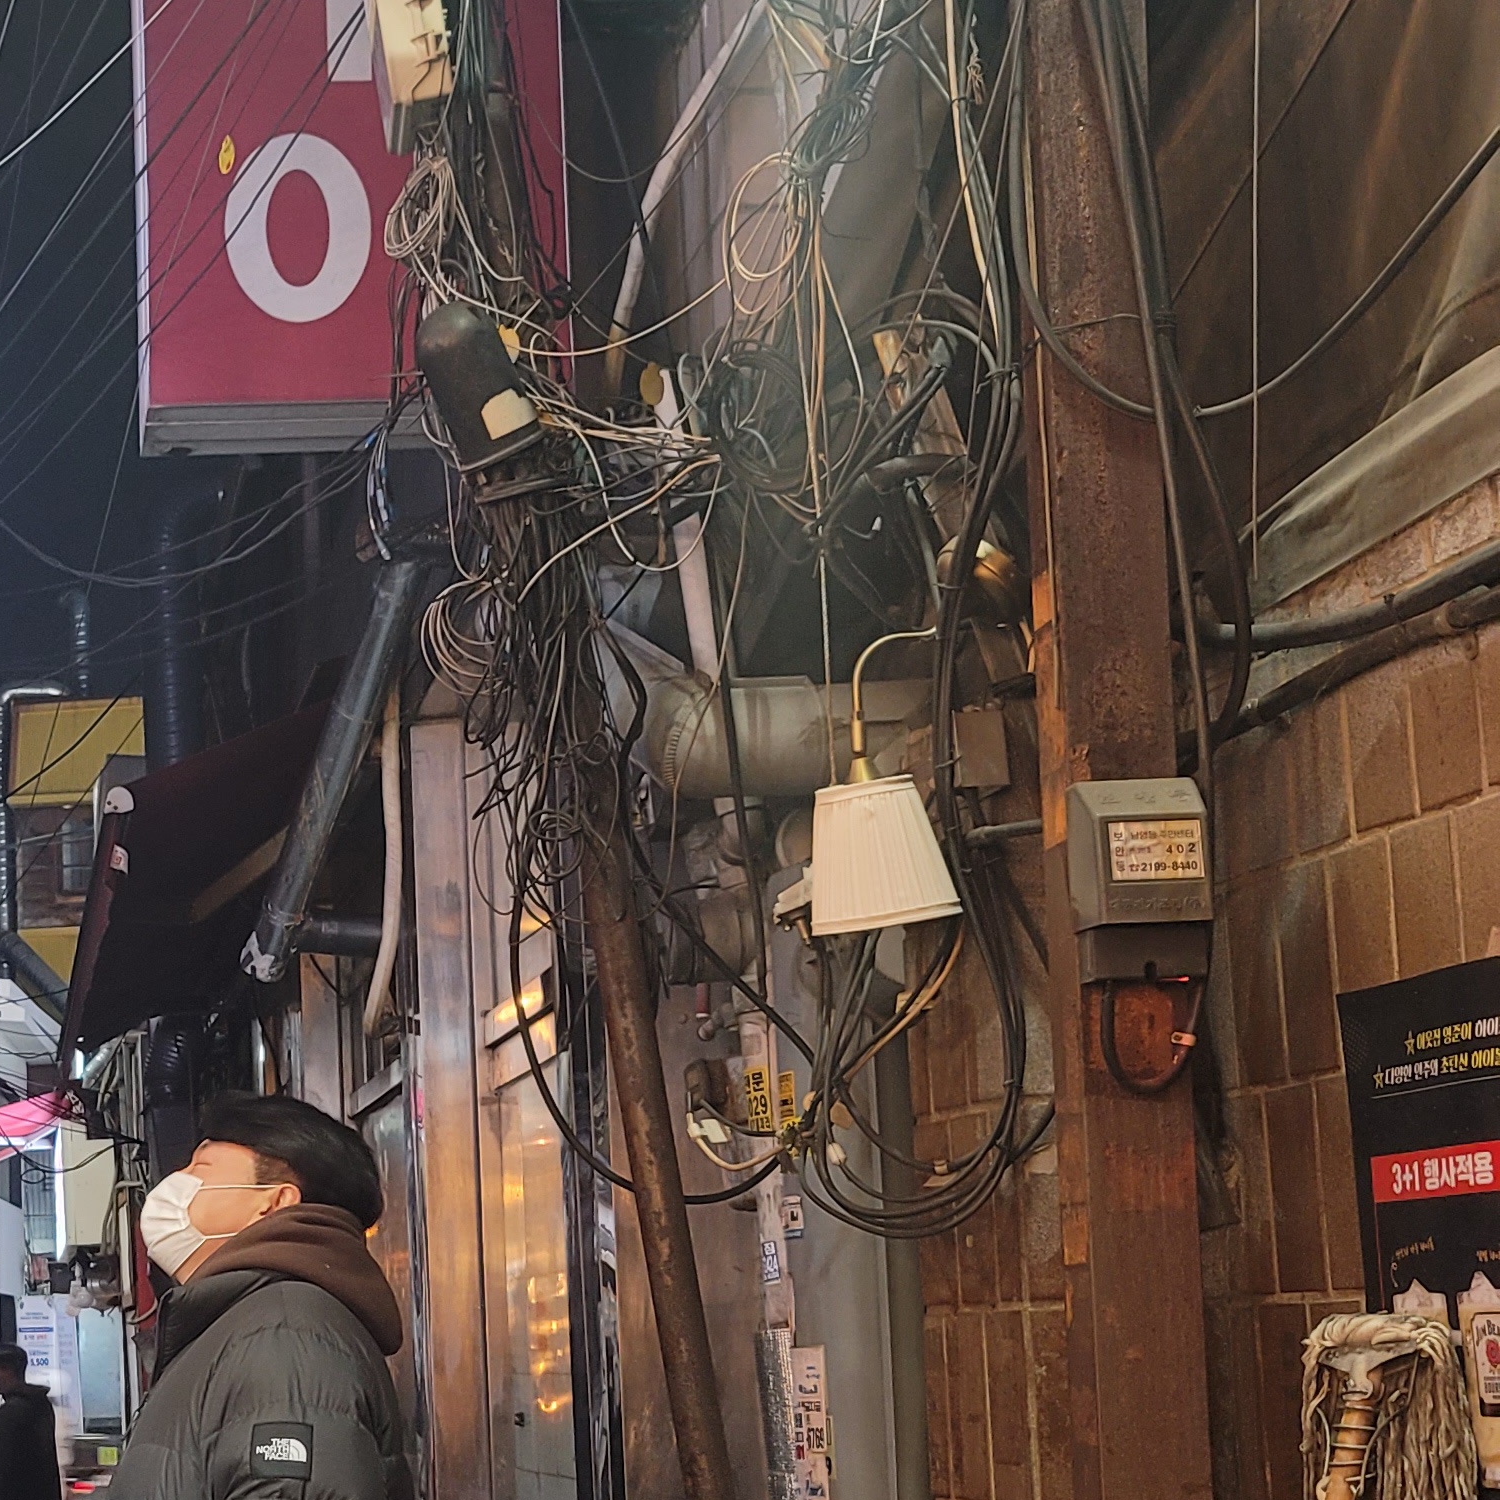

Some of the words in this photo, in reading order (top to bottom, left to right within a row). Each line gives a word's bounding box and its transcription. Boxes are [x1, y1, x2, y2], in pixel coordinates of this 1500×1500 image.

[1141, 860, 1198, 872] 2199-8440
[1416, 1031, 1441, 1051] 이웃집
[1474, 1016, 1500, 1038] 하이
[1391, 1160, 1420, 1194] 3+1
[1423, 1151, 1494, 1191] 행사적용
[271, 1438, 290, 1446] THE
[256, 1445, 290, 1454] NORTH
[264, 1453, 290, 1461] FACE
